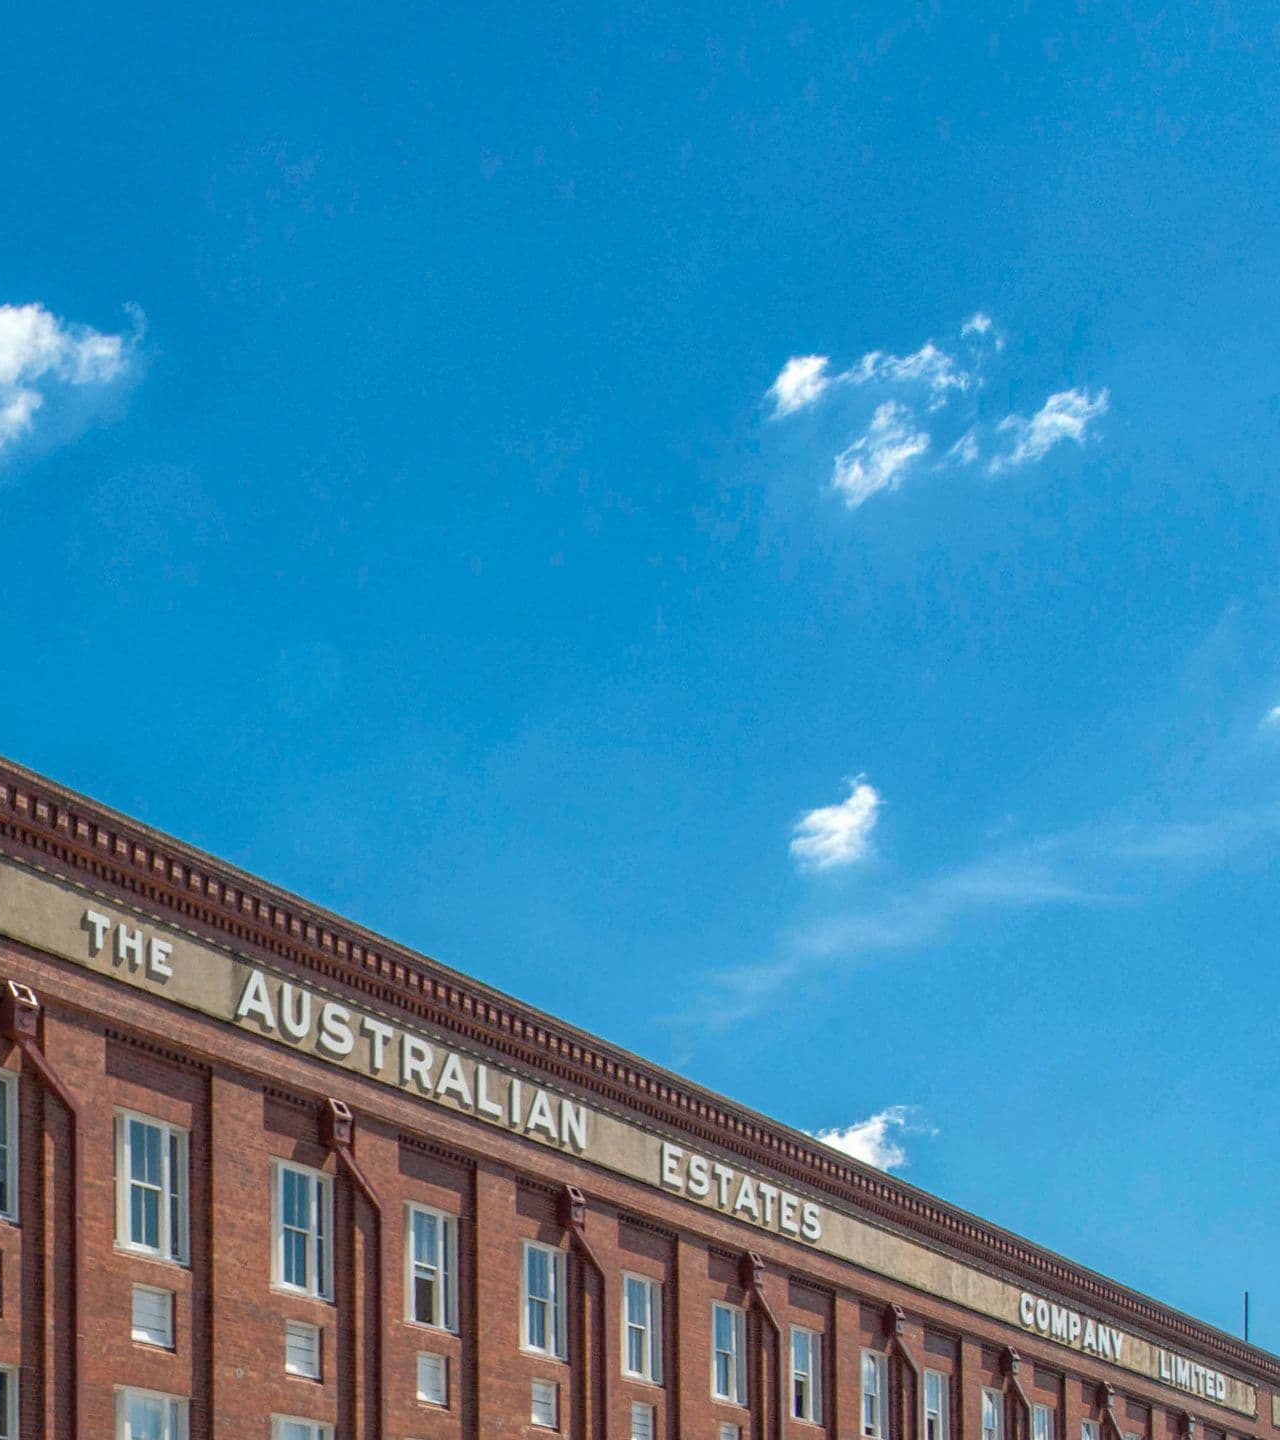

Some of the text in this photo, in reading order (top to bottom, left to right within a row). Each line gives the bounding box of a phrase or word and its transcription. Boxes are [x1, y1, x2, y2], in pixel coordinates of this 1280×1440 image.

[85, 909, 1226, 1400] THE AUSTRALIAN ESTATES COMPANY LIMITED
